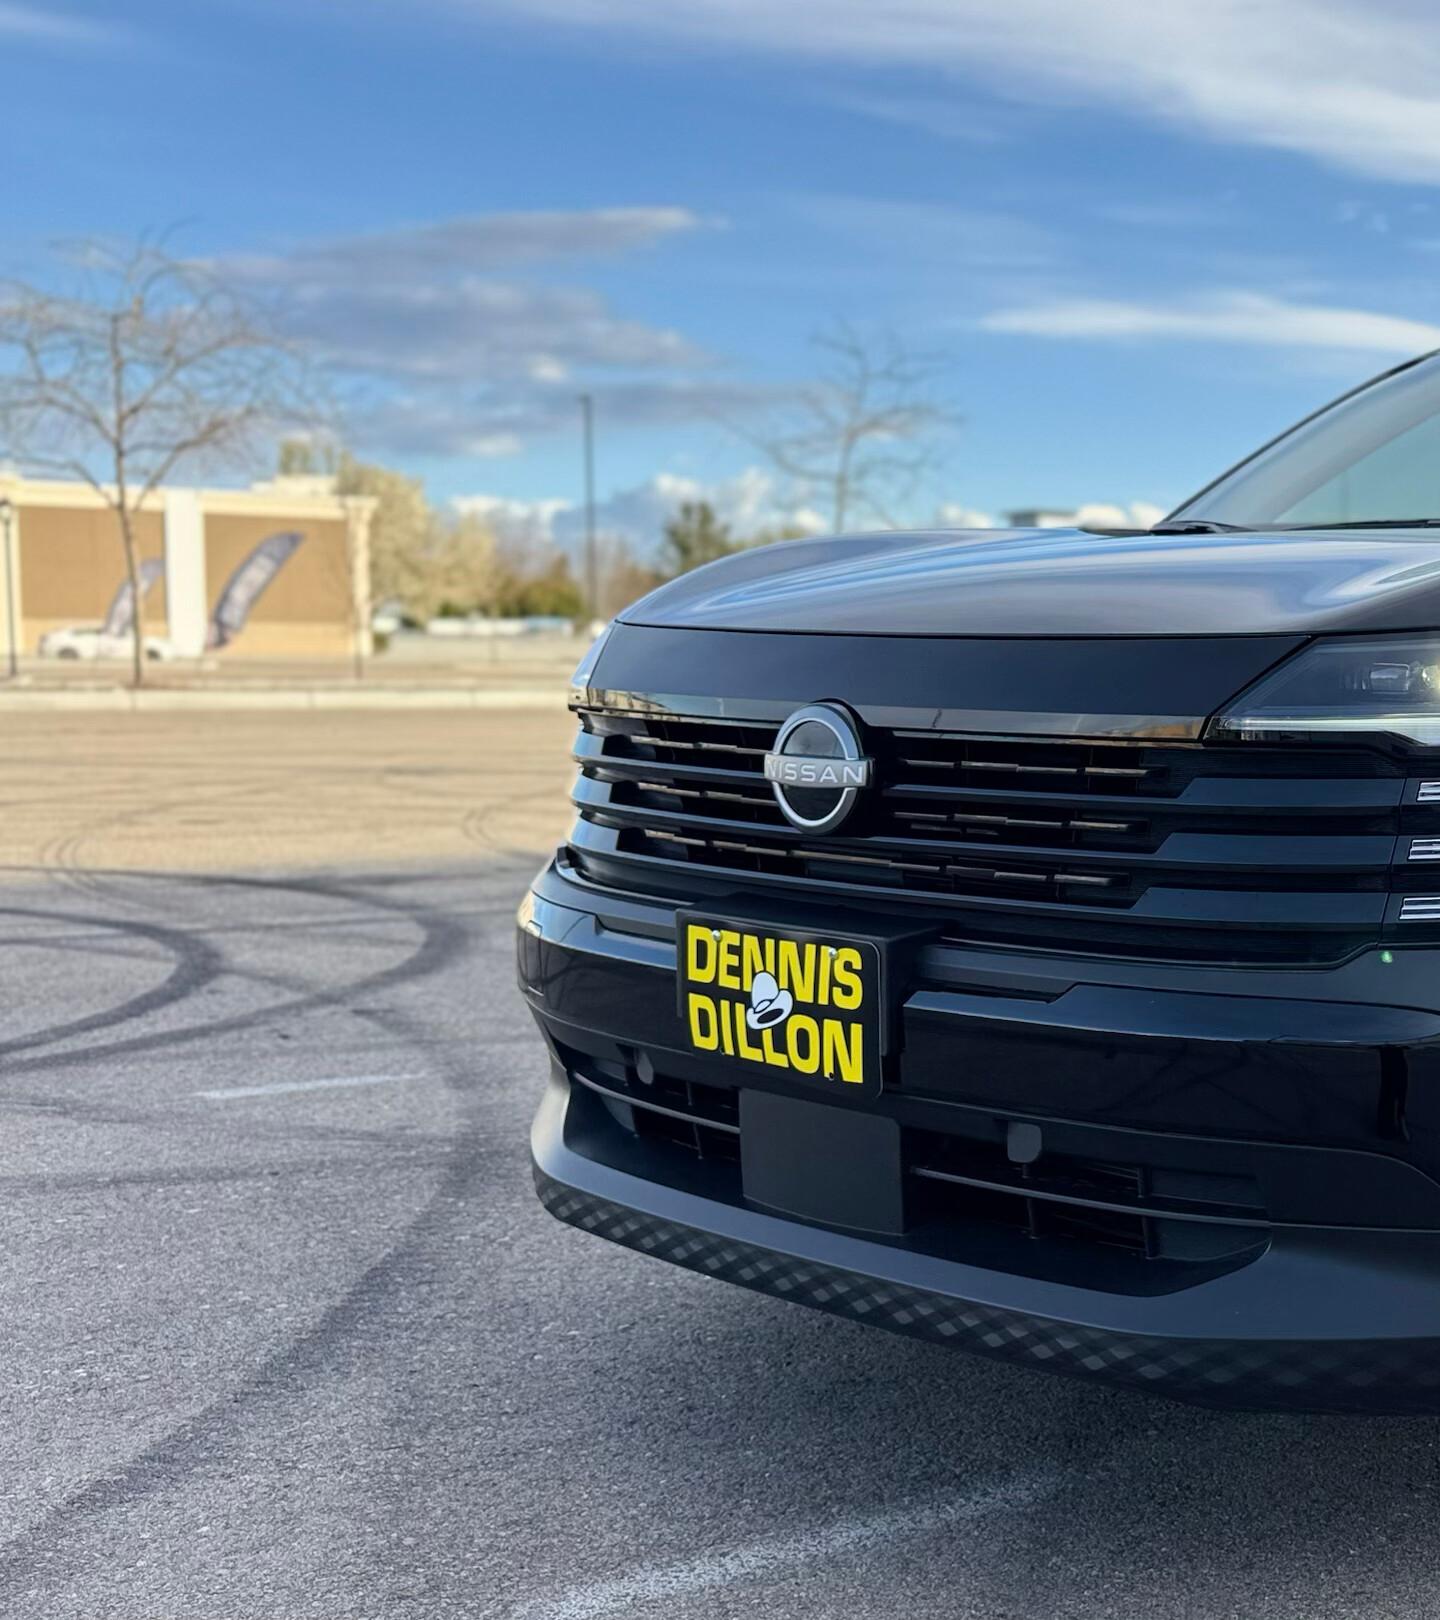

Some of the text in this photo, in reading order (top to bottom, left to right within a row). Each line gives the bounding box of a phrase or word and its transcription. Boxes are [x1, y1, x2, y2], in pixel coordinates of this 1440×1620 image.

[765, 758, 863, 783] NISSAN
[687, 924, 863, 1011] DENNIS
[688, 992, 864, 1084] DILLON
